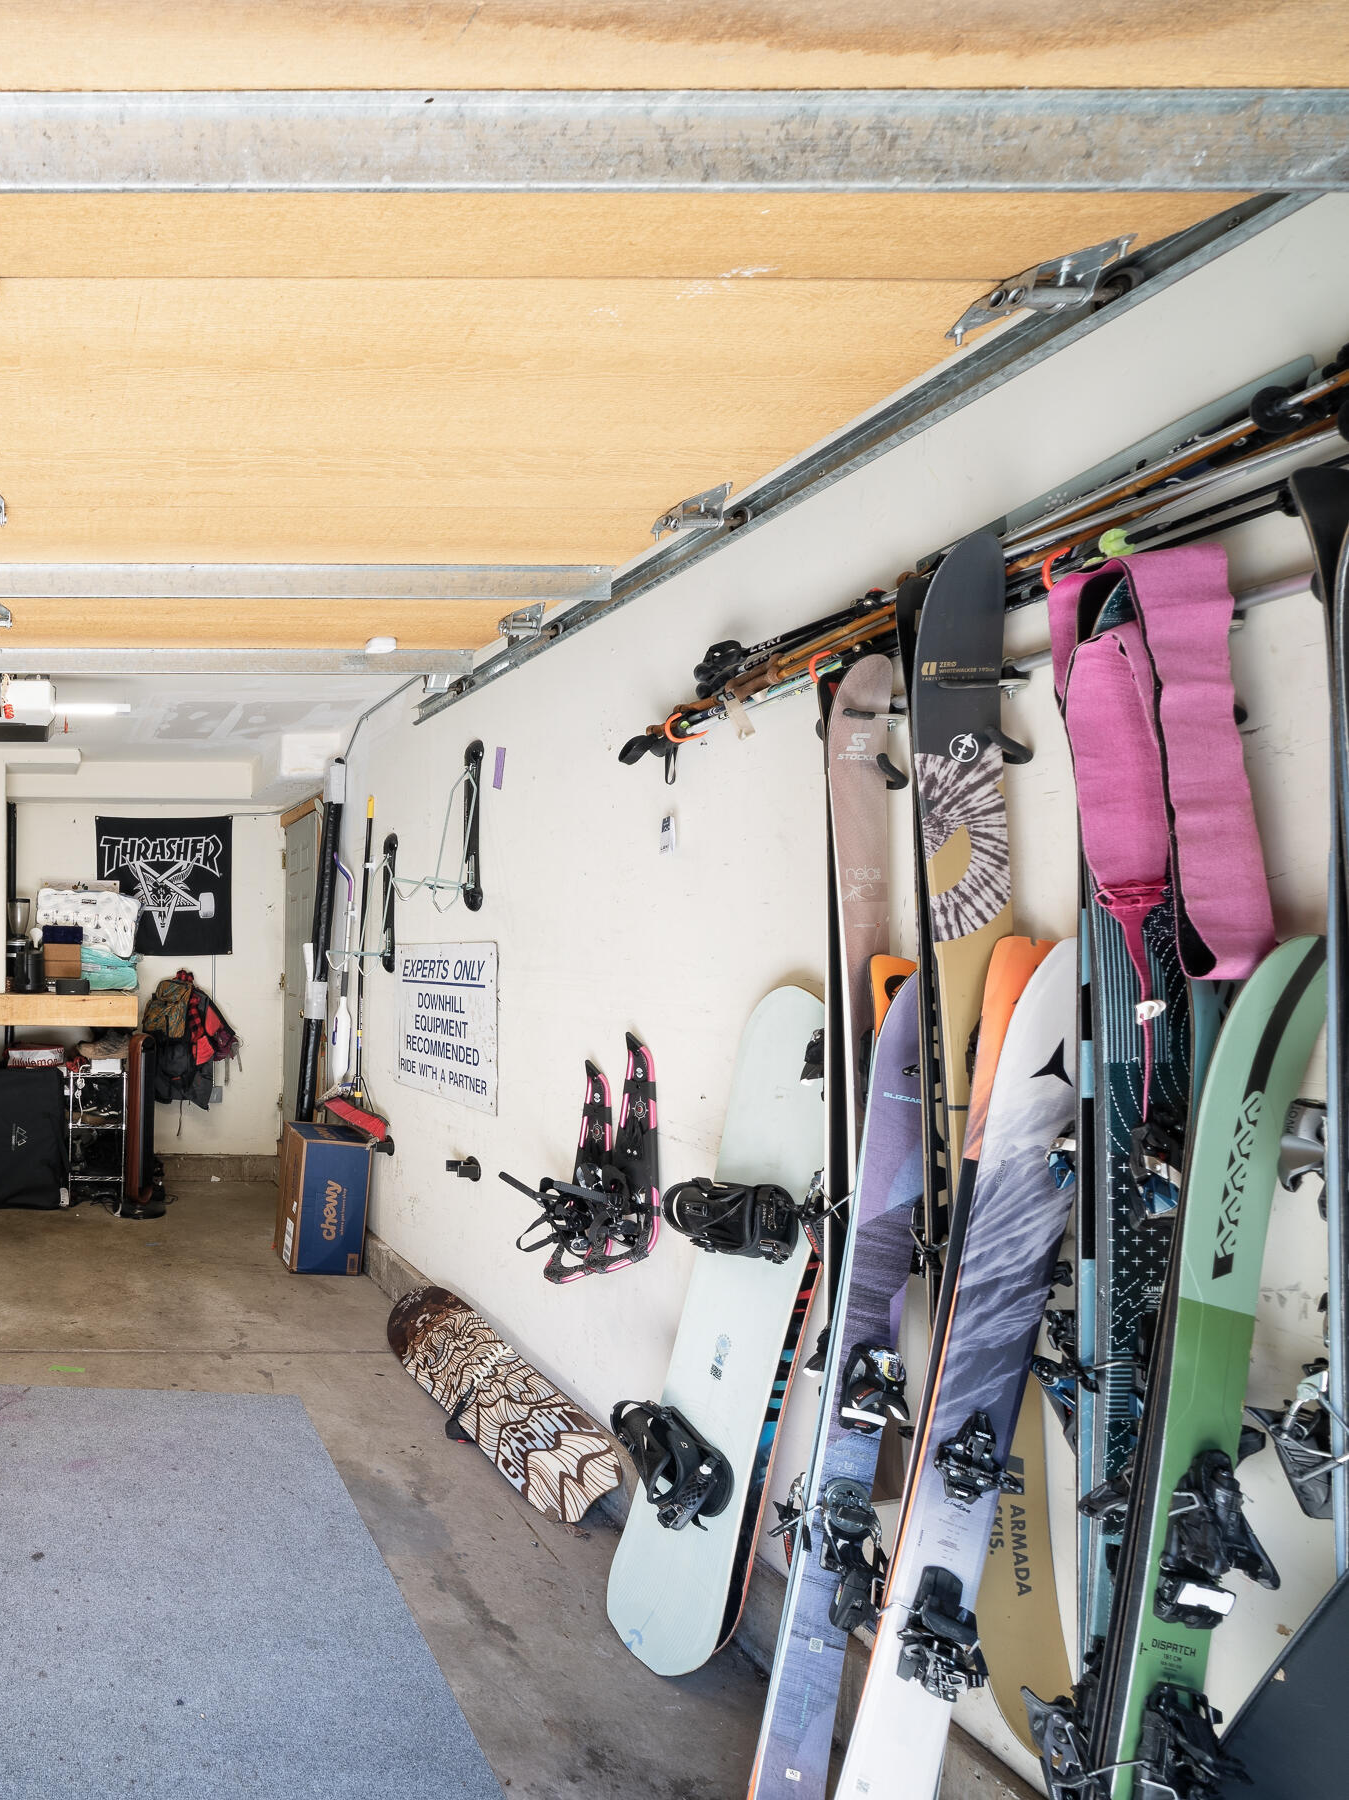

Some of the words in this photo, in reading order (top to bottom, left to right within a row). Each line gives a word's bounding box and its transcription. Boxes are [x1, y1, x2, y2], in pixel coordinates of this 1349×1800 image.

[100, 834, 222, 878] THRASHER
[402, 959, 450, 980] EXPERTS
[453, 959, 486, 982] ONLY
[417, 992, 466, 1015] DOWNHILL
[414, 1014, 468, 1040] EQUIPMENT
[406, 1034, 480, 1067] RECOMMENDED
[400, 1057, 417, 1075] RIDE
[440, 1068, 446, 1084] A
[448, 1070, 488, 1097] PARTNER
[321, 1179, 343, 1242] chewy
[1010, 1503, 1033, 1597] ARMADA
[1151, 1638, 1197, 1657] DISPATCH
